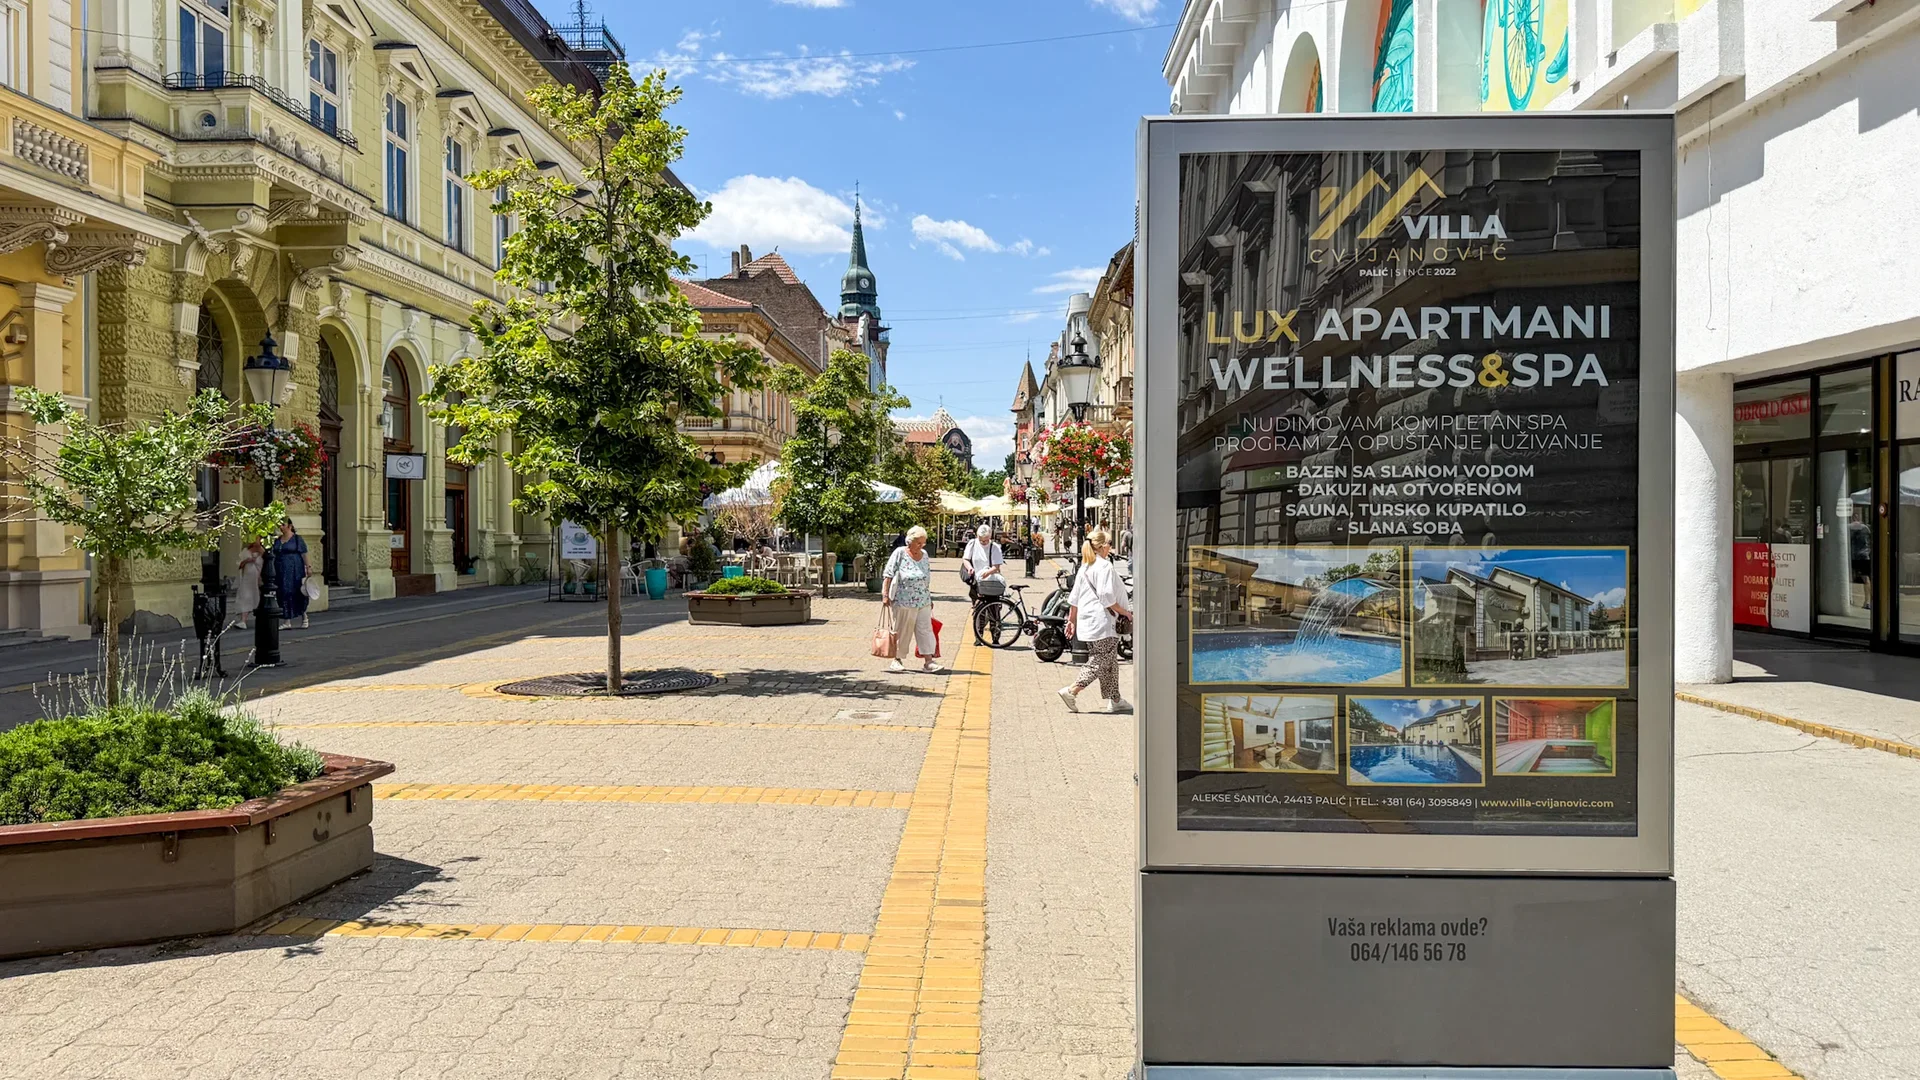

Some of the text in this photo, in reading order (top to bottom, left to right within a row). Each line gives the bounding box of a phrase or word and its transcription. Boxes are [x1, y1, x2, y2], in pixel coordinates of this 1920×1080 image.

[1401, 215, 1507, 239] VILLA
[1310, 243, 1506, 263] CVIJANOVIĆ
[1359, 267, 1388, 277] PALIĆ
[1395, 268, 1432, 276] SINCE
[1434, 268, 1456, 276] 2022
[1207, 305, 1610, 344] LUX APARTMANI
[1209, 353, 1609, 390] WELLNESS&SPA
[1734, 403, 1768, 422] OBRO
[1243, 415, 1567, 432] NUDIMO VAM KOMPLETAN SPA
[1214, 435, 1320, 451] PROGRAM
[1327, 435, 1352, 450] ZA
[1358, 431, 1482, 450] OPUŠTANJE
[1501, 431, 1603, 449] UŽIVANJE
[1286, 465, 1347, 478] BAZEN
[1352, 465, 1376, 478] SA
[1380, 465, 1458, 478] SLANOM
[1463, 464, 1534, 478] VODOM
[1298, 483, 1366, 496] ĐAKUZI
[1372, 483, 1398, 496] NA
[1403, 483, 1521, 496] OTVORENOM
[1285, 504, 1354, 518] SAUNA,
[1358, 503, 1430, 516] TURSKO
[1436, 503, 1526, 516] KUPATILO
[1348, 521, 1408, 534] SLANA
[1412, 521, 1463, 534] SOBA
[1782, 552, 1797, 562] CITY
[1743, 575, 1763, 585] DOBAR
[1191, 794, 1231, 803] ALEKSE
[1233, 793, 1281, 805] ŠANTIĆA,
[1283, 795, 1313, 804] 24413
[1316, 795, 1346, 805] PALIĆ
[1355, 797, 1379, 806] TEL.:
[1382, 798, 1403, 806] +381
[1406, 798, 1426, 808] (64)
[1428, 798, 1472, 807] 3095849
[1480, 799, 1614, 809] www.villa-cvijanovic.com
[1328, 917, 1488, 936] Vaša reklama ovde?
[1350, 942, 1466, 964] 064/146 56 78
